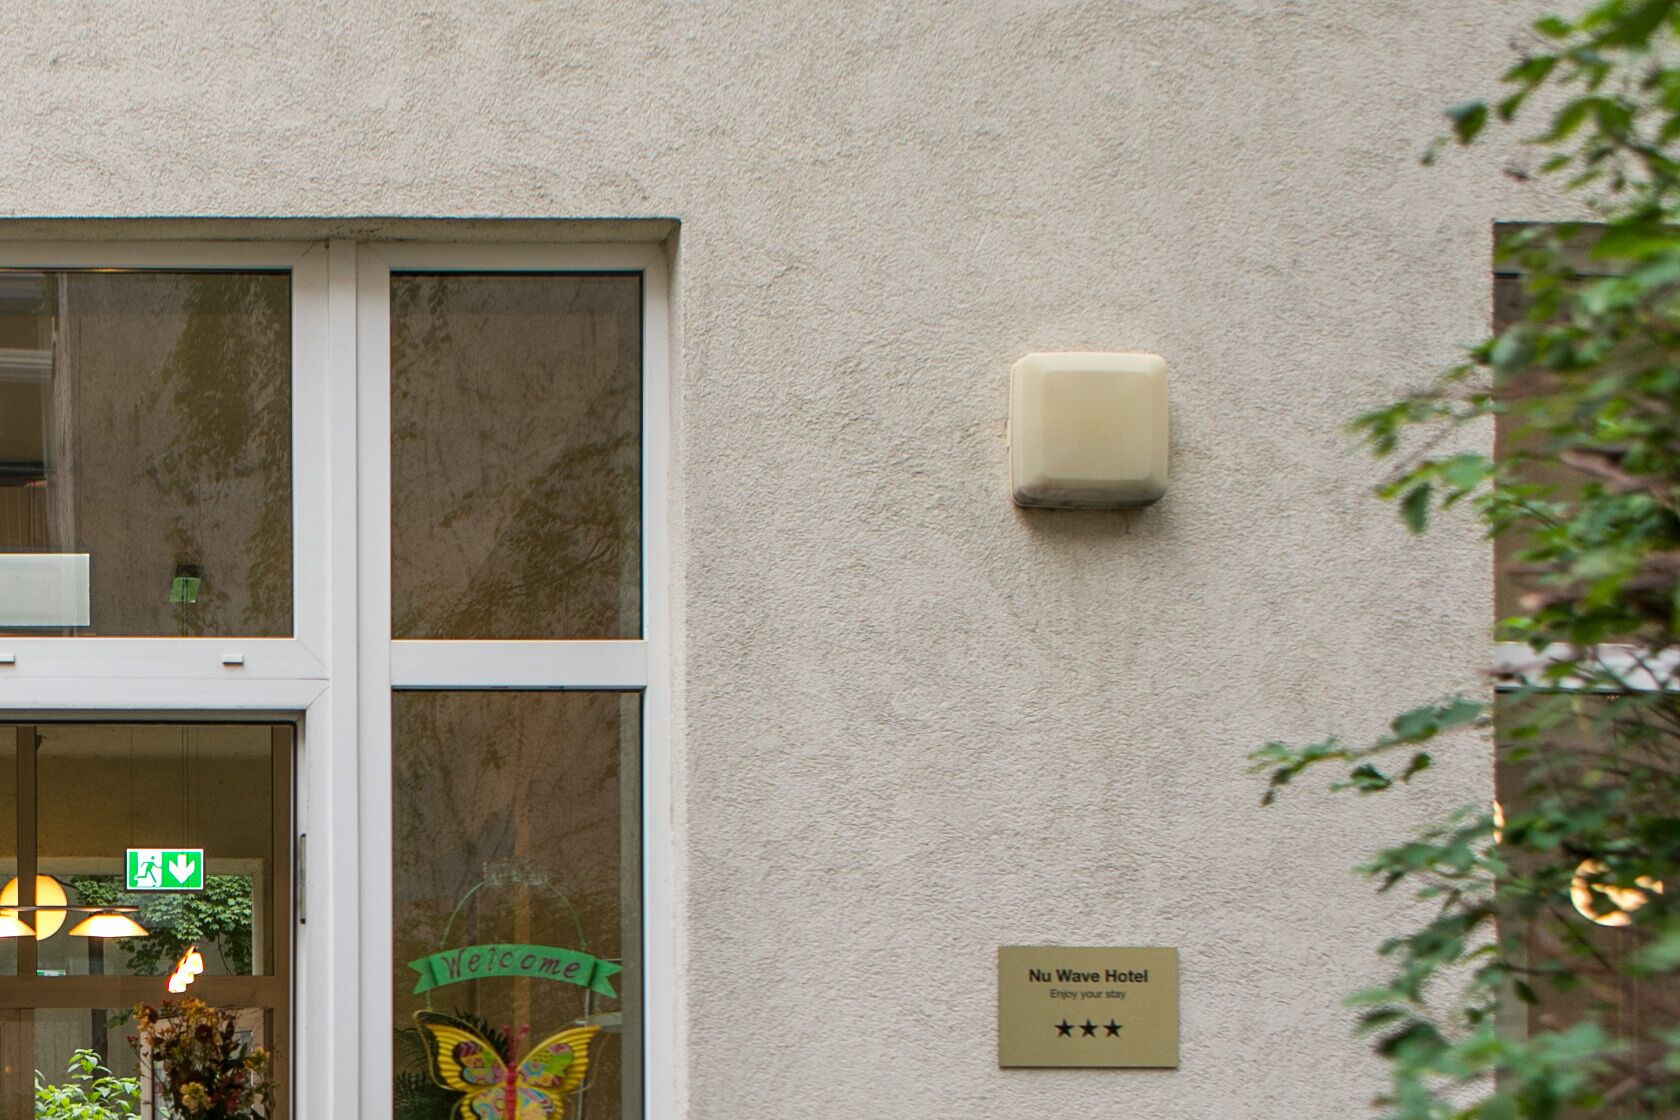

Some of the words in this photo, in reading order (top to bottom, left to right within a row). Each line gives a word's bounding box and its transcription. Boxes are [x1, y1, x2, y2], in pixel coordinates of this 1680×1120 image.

[441, 947, 581, 979] Welcome
[1028, 968, 1052, 983] Nu
[1056, 968, 1100, 983] Wave
[1105, 968, 1148, 983] Hotel
[1049, 989, 1078, 1000] Enjoy
[1080, 991, 1103, 1000] your
[1105, 989, 1126, 1000] stay
